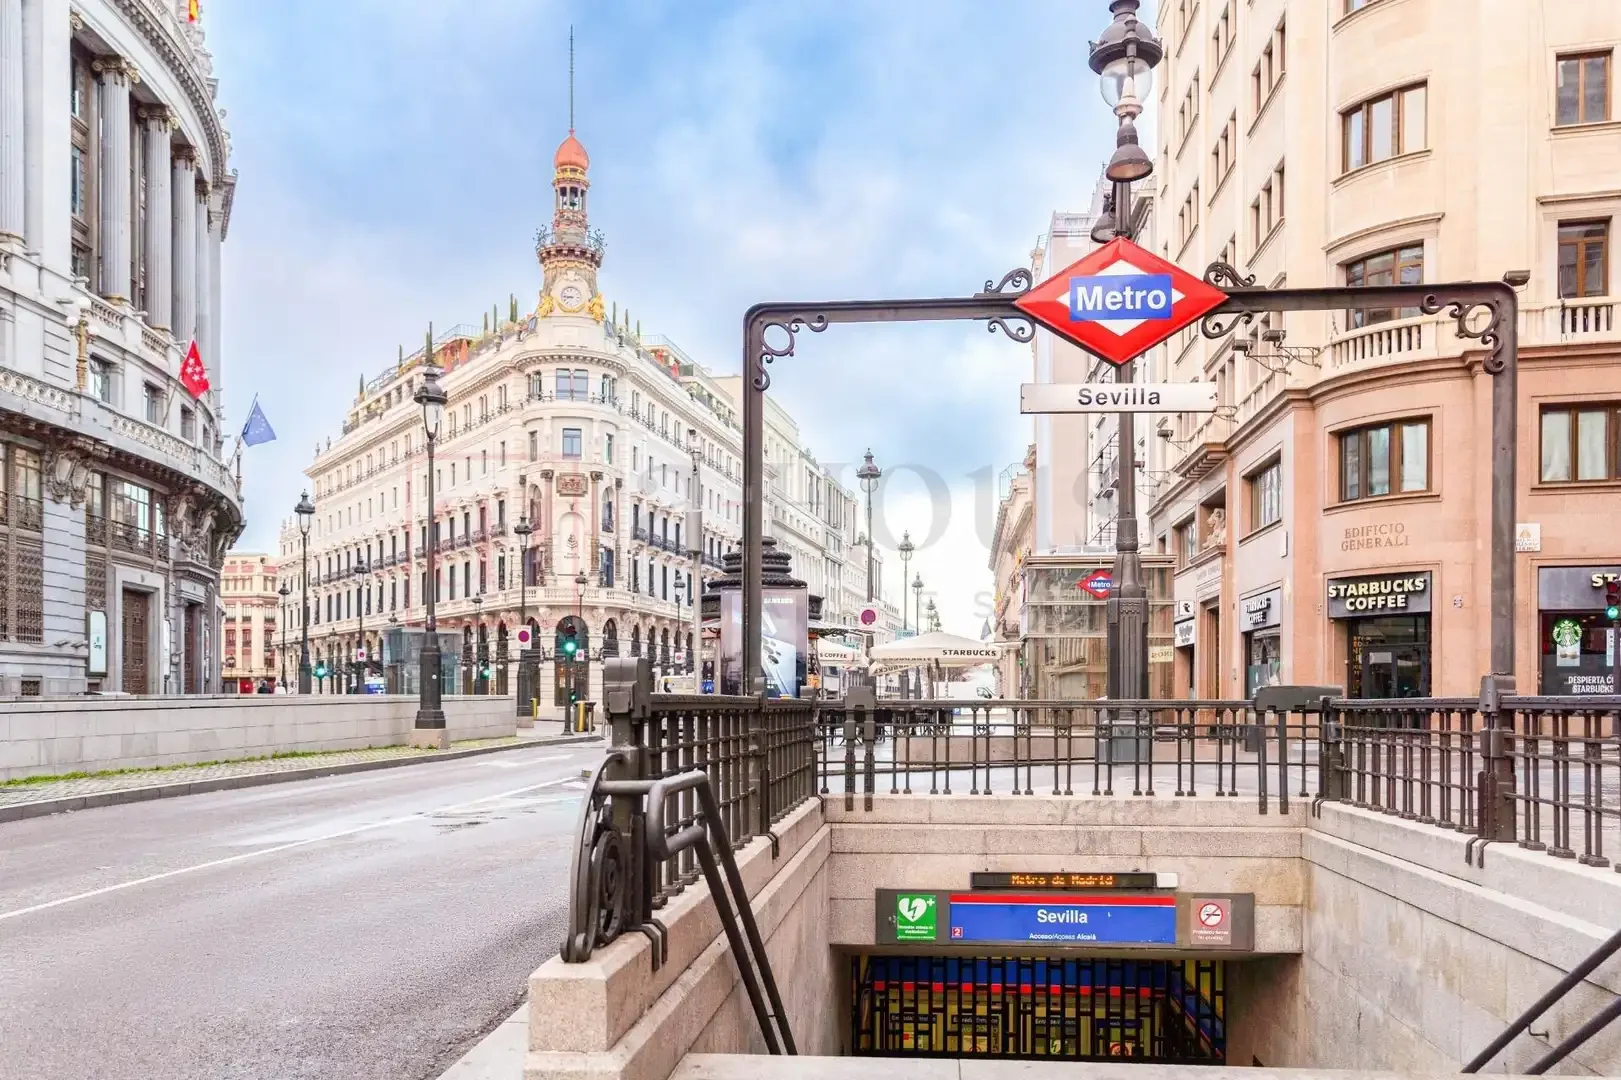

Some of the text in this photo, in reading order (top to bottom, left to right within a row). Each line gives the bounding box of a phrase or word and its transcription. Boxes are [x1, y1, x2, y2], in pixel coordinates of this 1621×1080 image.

[1076, 285, 1167, 311] Metro
[1077, 388, 1161, 406] Sevilla
[1344, 522, 1405, 539] EDIFICIO
[1341, 536, 1409, 551] GENERALI
[1328, 577, 1425, 598] STARBUCKS
[1591, 573, 1621, 587] ST
[1345, 594, 1407, 611] COFFEE
[942, 649, 997, 657] STARBUCKS
[1568, 675, 1606, 685] DESPIERTA
[1572, 684, 1614, 694] STARBUCKS
[1012, 875, 1113, 885] Metro de Madrid
[1037, 908, 1088, 924] Sevilla
[954, 928, 961, 936] 2
